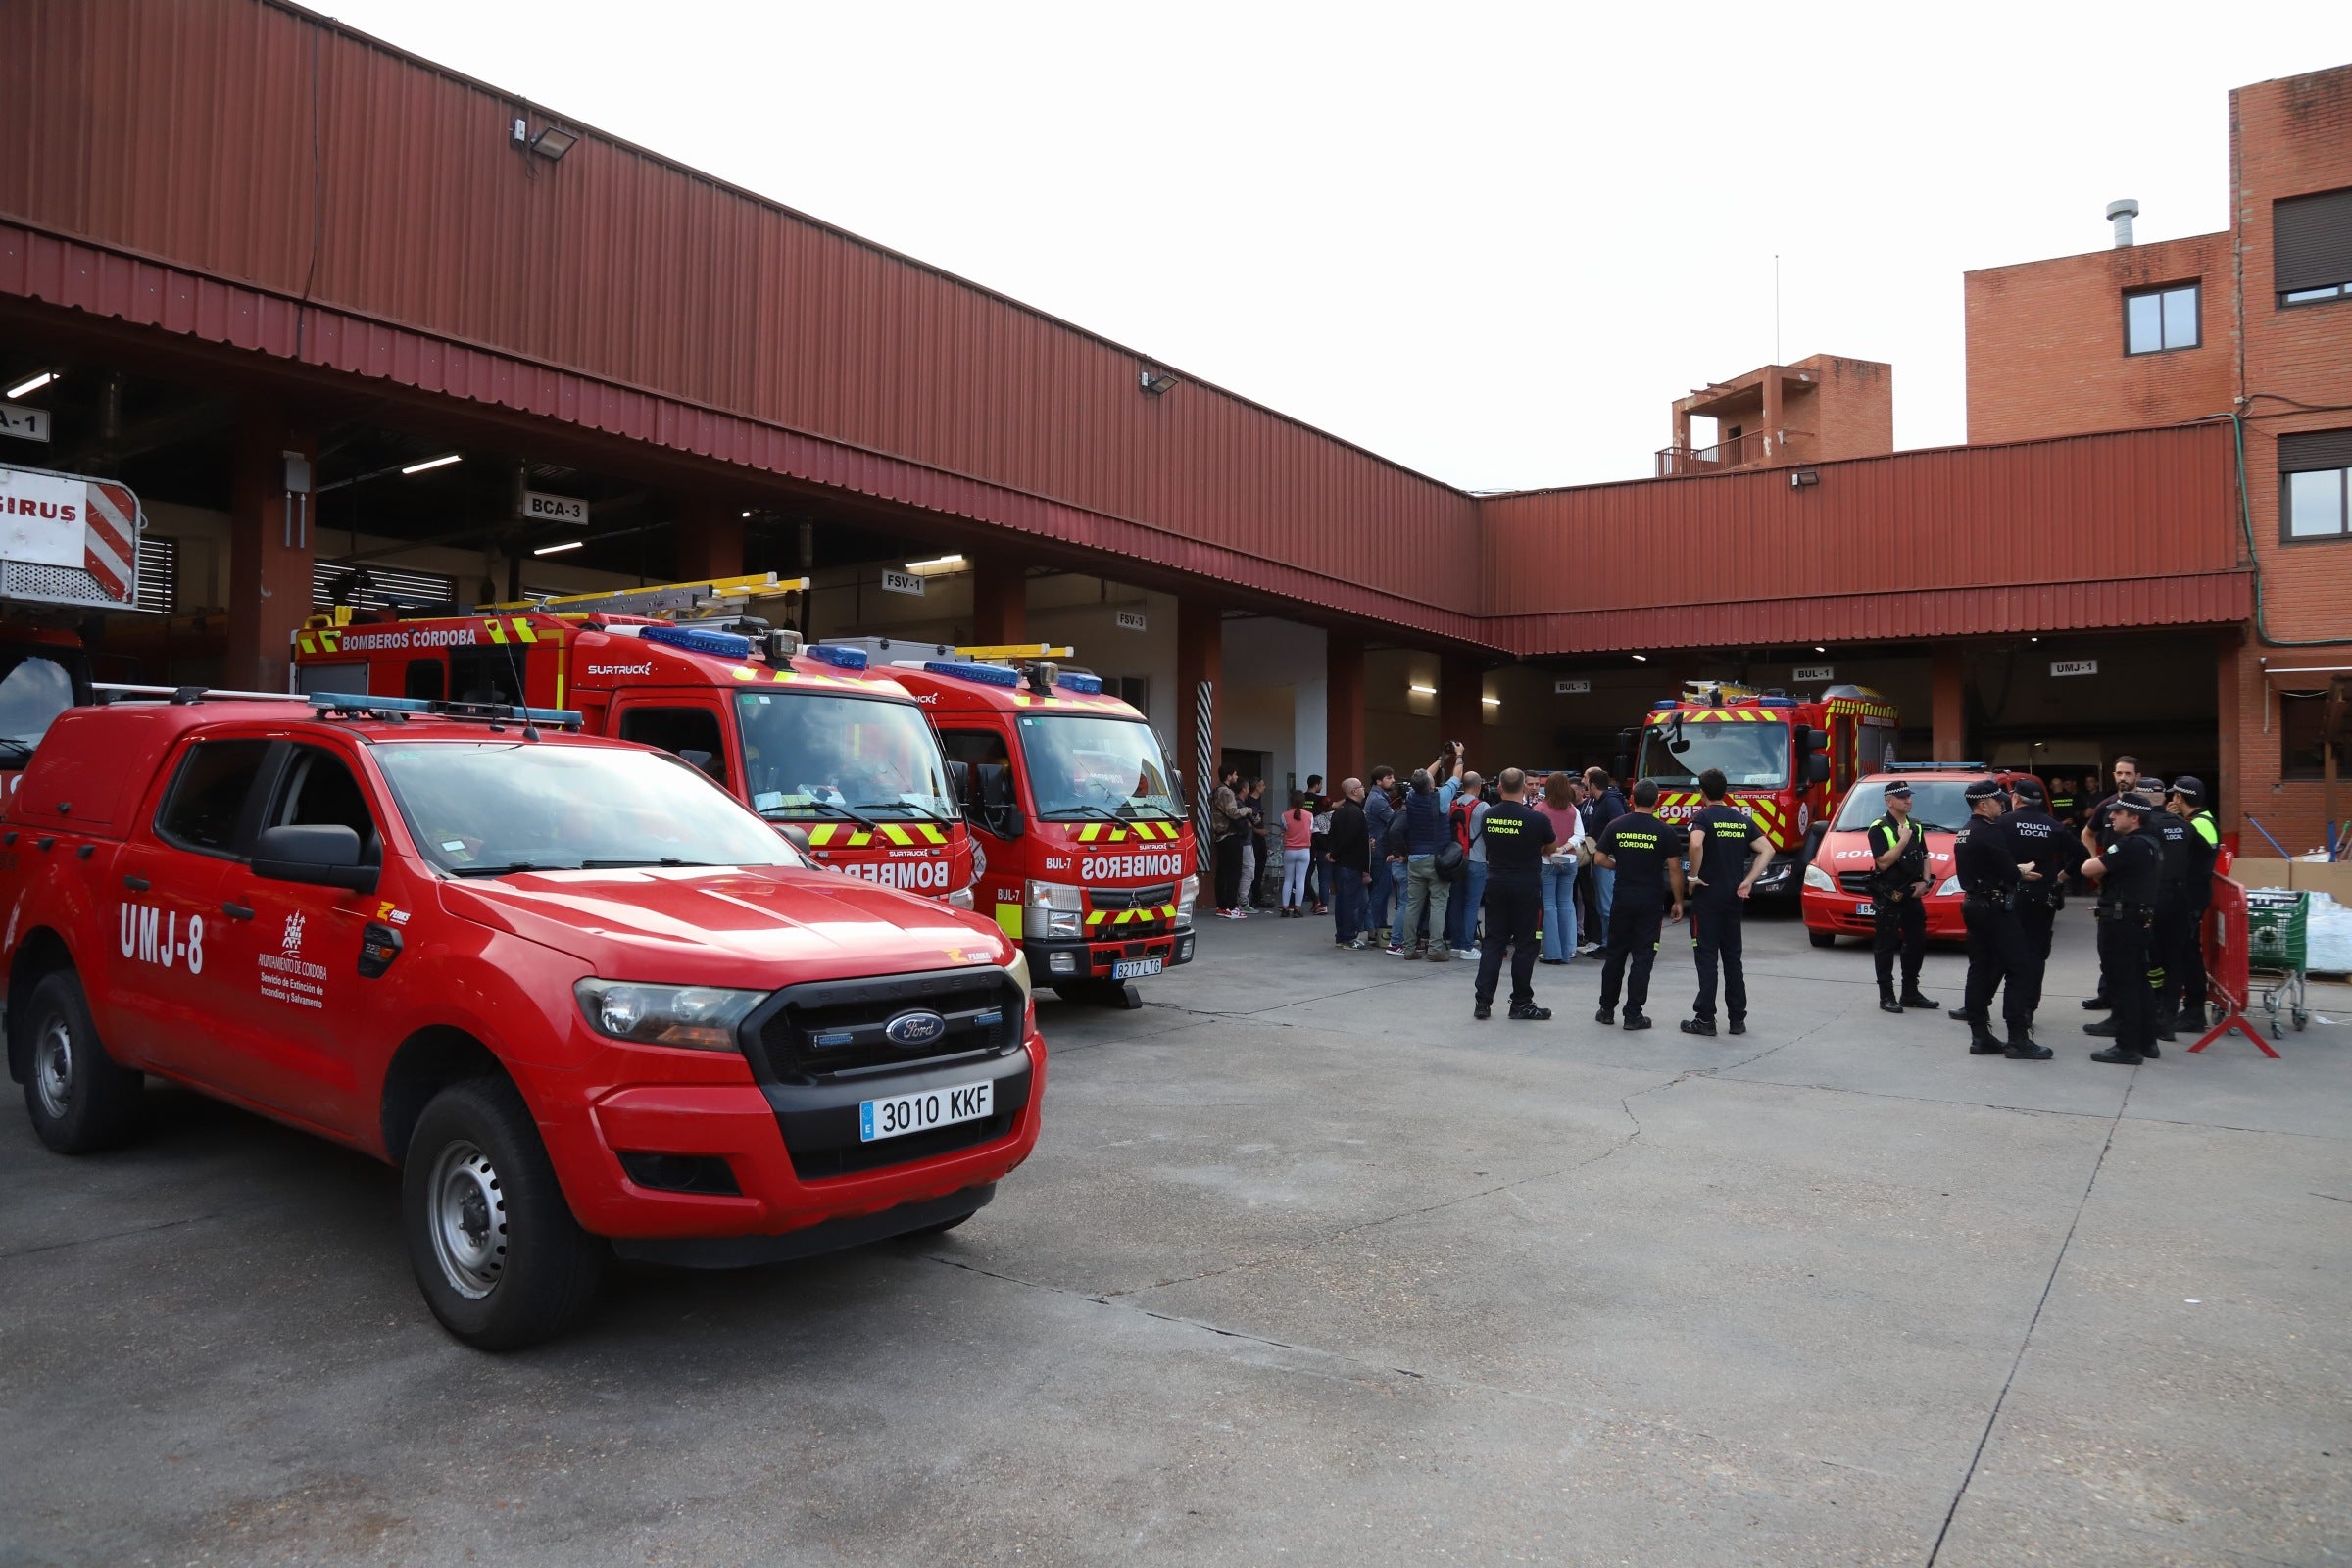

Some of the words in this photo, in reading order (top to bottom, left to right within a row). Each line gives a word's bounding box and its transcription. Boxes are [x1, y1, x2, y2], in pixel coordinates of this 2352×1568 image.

[0, 495, 76, 522] IRUS
[532, 498, 581, 517] BCA-3
[887, 574, 921, 591] FSV-1
[1119, 613, 1144, 627] FSV-3
[342, 632, 409, 651] BOMBEROS
[412, 627, 477, 648] CÓRDOBA
[1797, 669, 1829, 678] BUL-1
[2056, 662, 2092, 673] UMJ-1
[1559, 682, 1588, 691] BUL-3
[1485, 817, 1523, 827] BOMBEROS
[1713, 821, 1747, 830] BOMBEROS
[1616, 832, 1658, 842] BOMBEROS
[2020, 829, 2048, 838] LOCAL
[1046, 858, 1072, 869] BUL-7
[997, 889, 1020, 901] BUL-7
[120, 902, 204, 974] UMJ-8
[258, 953, 294, 973] AYUNTAMIENTO
[295, 960, 302, 975] DE
[1117, 961, 1141, 978] 8217
[1143, 959, 1160, 974] LTG
[261, 971, 281, 986] Servicio
[282, 976, 289, 987] de
[290, 978, 316, 994] Extinción
[316, 985, 324, 996] de
[261, 985, 285, 1000] Incendios
[286, 993, 291, 1004] y
[290, 992, 323, 1009] Salvamento
[903, 1018, 935, 1039] Ford
[882, 1095, 939, 1132] 3010
[951, 1084, 989, 1119] KKF
